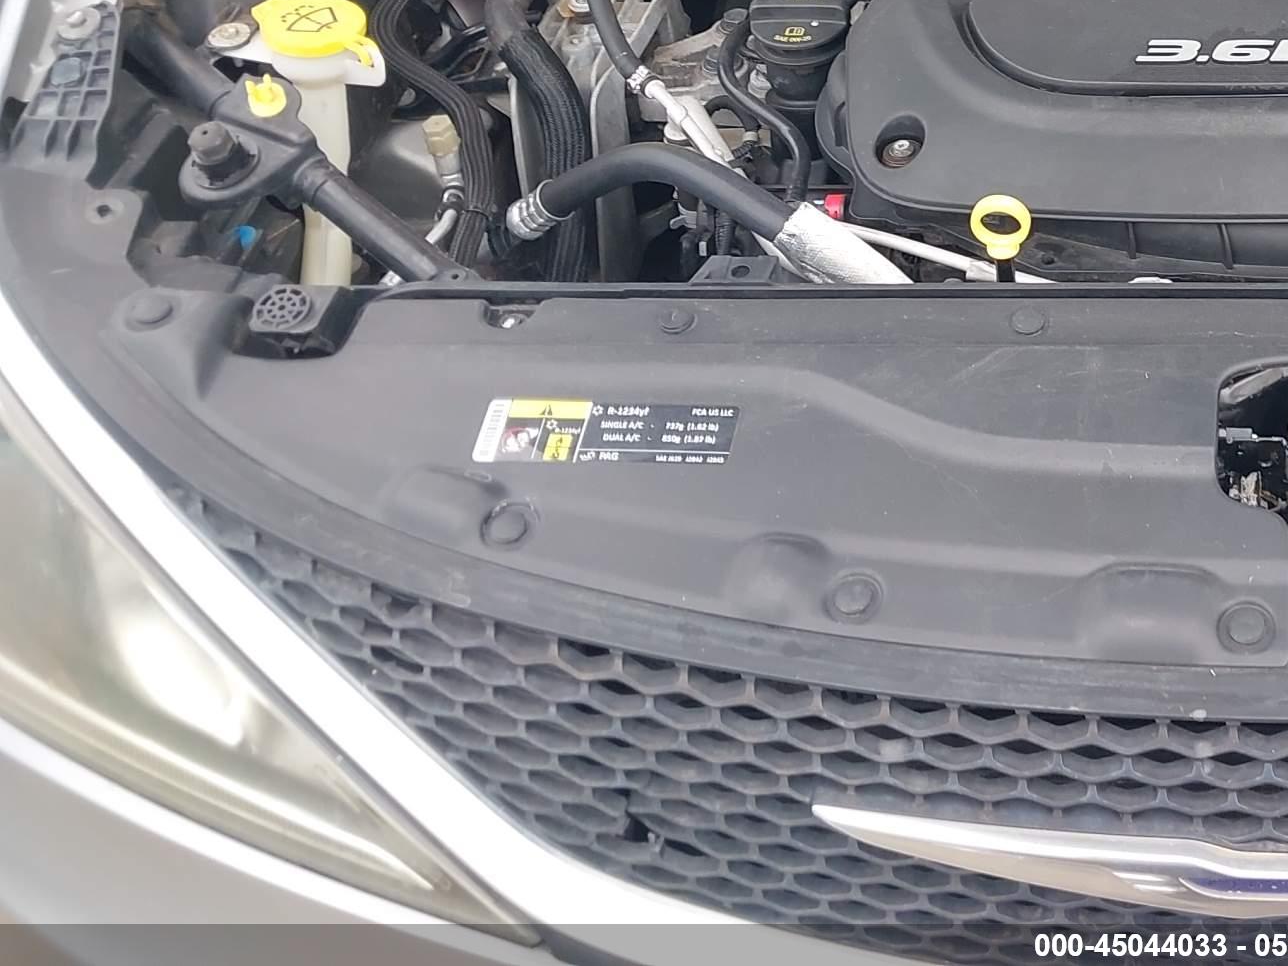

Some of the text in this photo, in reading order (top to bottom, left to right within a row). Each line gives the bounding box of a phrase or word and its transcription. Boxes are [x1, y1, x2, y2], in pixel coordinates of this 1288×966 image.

[607, 406, 650, 417] R-1234yf
[692, 408, 735, 417] FCA US LLC
[600, 420, 628, 429] SINGLE
[628, 421, 645, 430] A/C
[602, 433, 624, 442] DUAL
[624, 434, 641, 442] A/C
[599, 451, 620, 461] PAG
